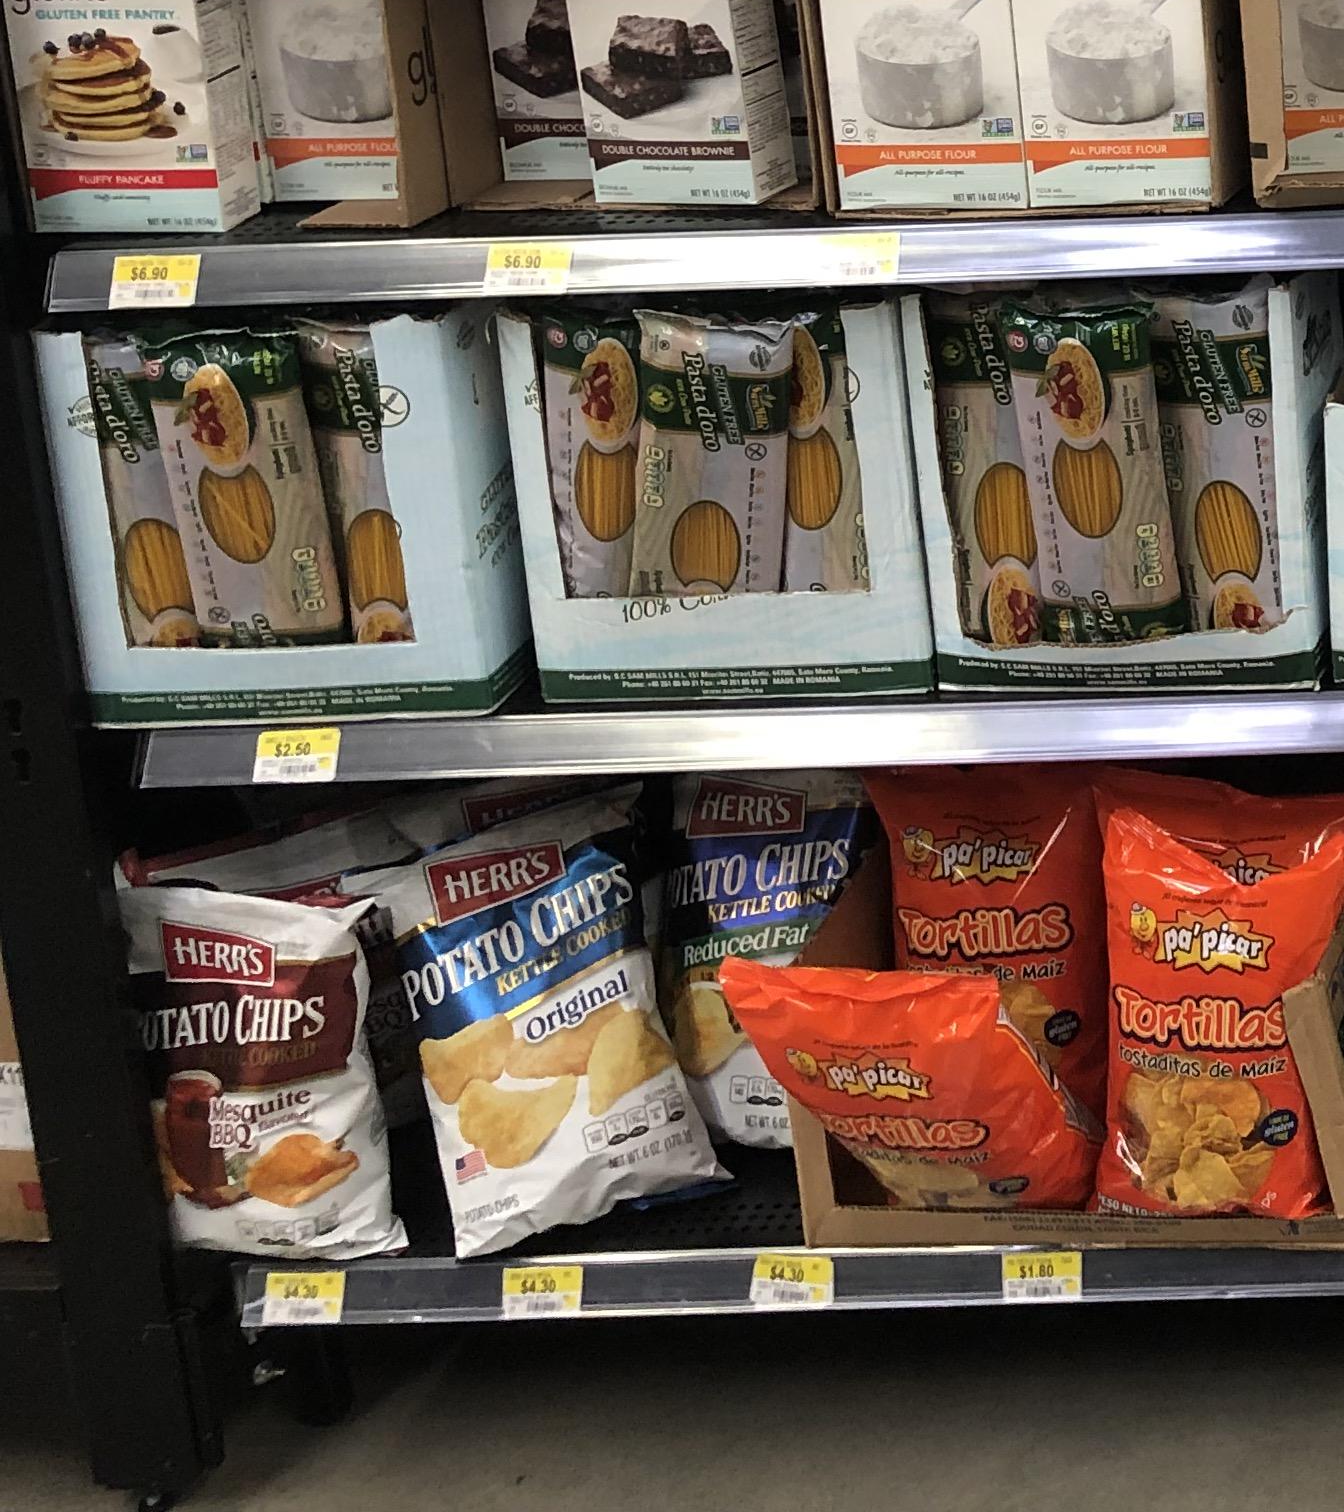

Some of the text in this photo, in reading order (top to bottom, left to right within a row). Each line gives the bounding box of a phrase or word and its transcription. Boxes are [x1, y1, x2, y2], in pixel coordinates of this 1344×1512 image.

[35, 8, 175, 20] GLUTEN FREE PANTRY
[602, 146, 735, 156] DOUBLE CHOCOLATE BROWNIE
[880, 148, 976, 159] ALL PURPOSE FLOUR
[130, 266, 168, 282] $6.90
[443, 851, 552, 903] HERR'S
[402, 863, 634, 1022] POTATO CHIPS
[683, 923, 811, 965] Reduced Fat
[900, 908, 1069, 957] Tortillas
[173, 938, 264, 975] HERR'S
[524, 971, 629, 1043] Original
[1208, 1058, 1233, 1077] de
[209, 1122, 253, 1149] BBQ
[1019, 1263, 1055, 1279] $1.80
